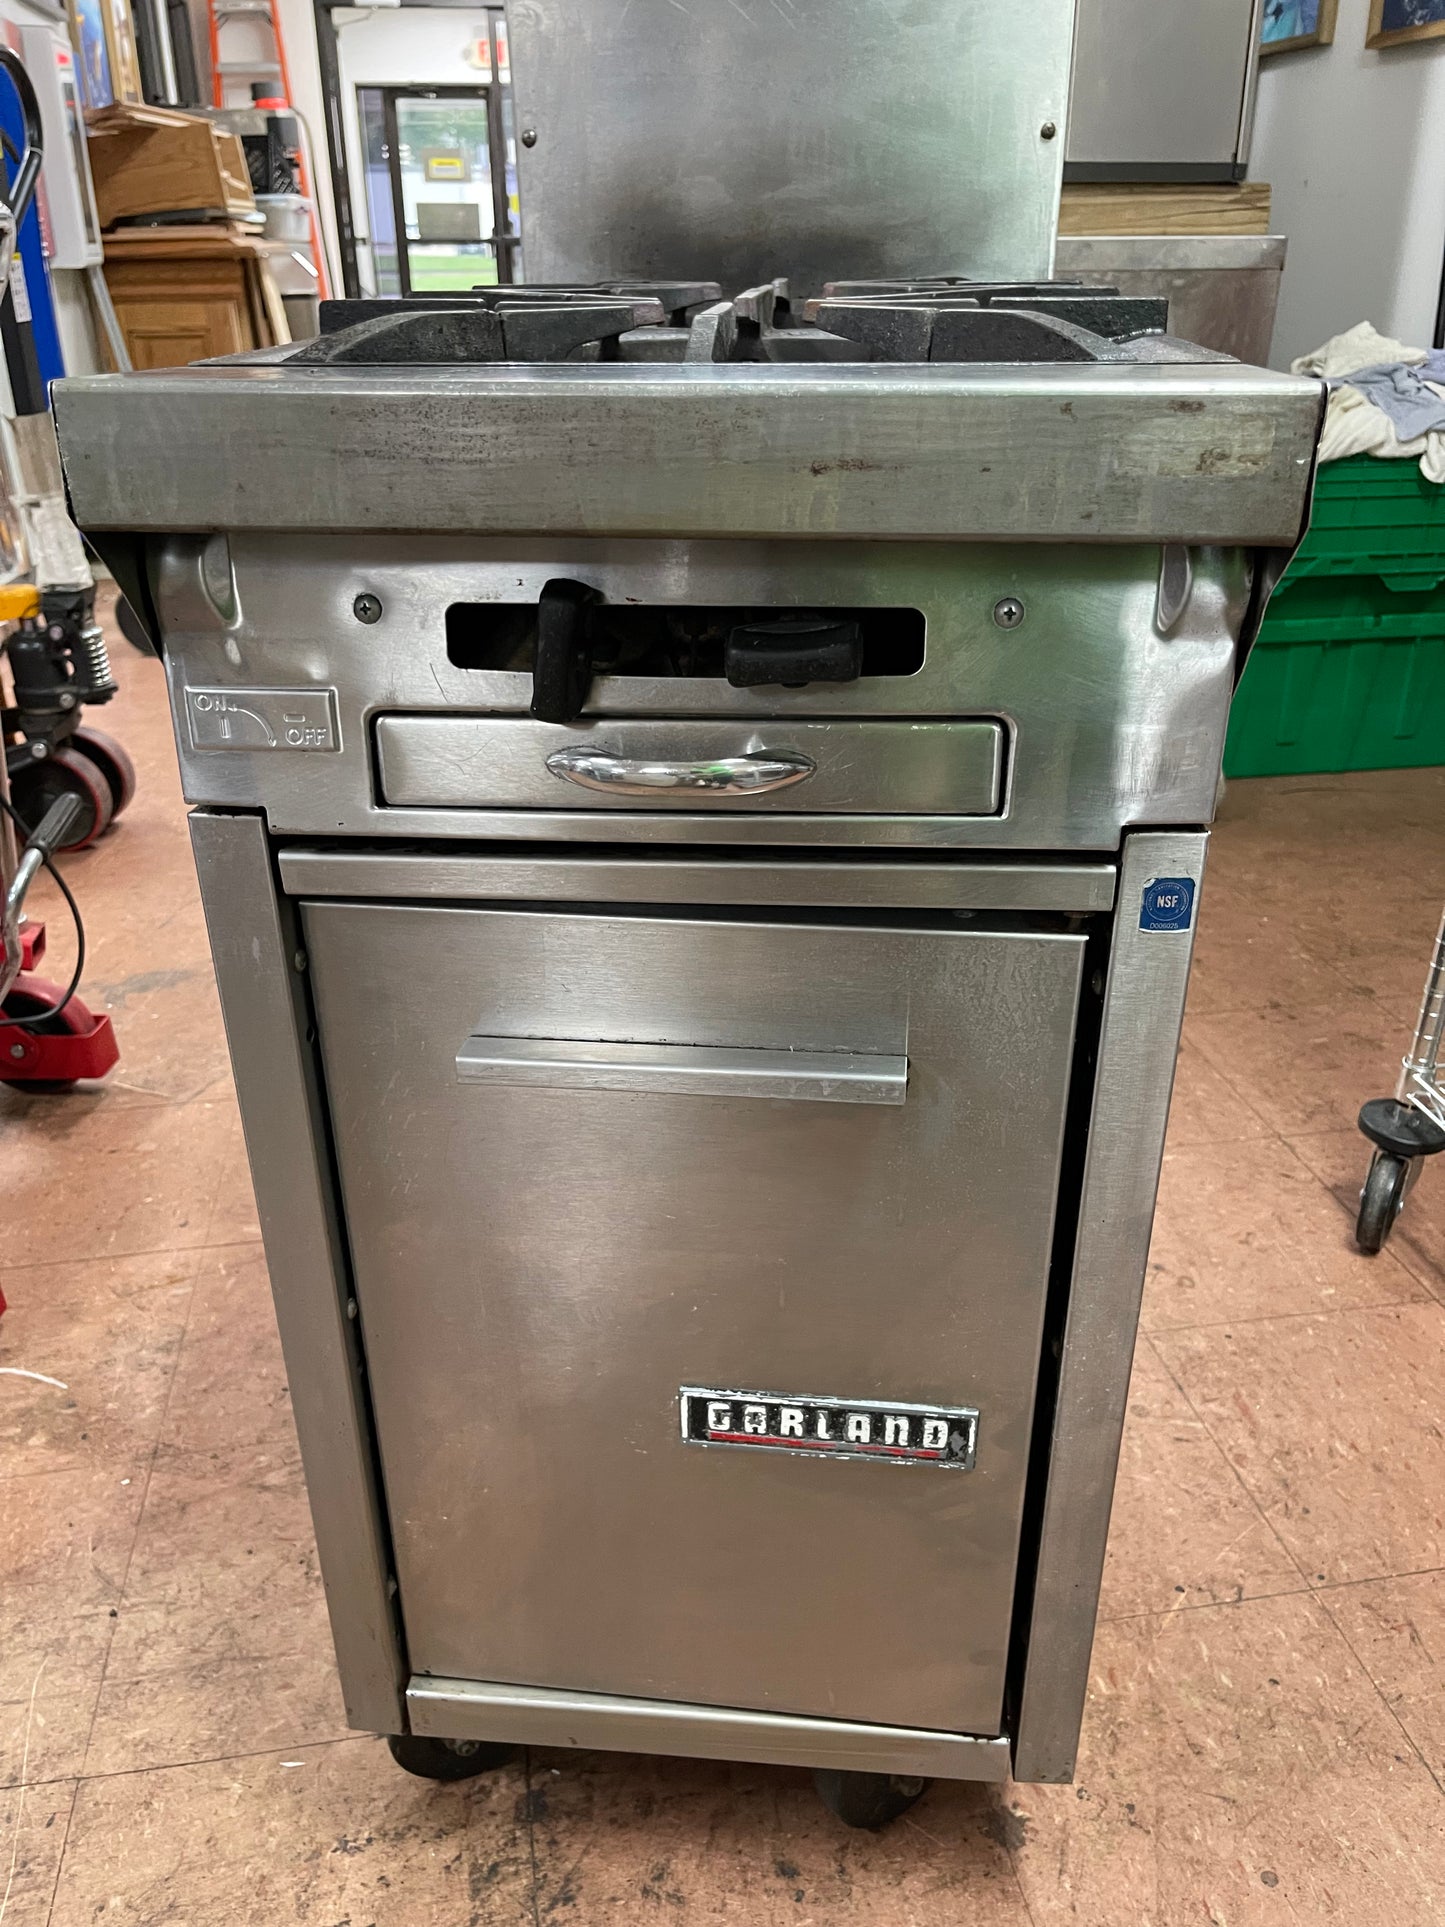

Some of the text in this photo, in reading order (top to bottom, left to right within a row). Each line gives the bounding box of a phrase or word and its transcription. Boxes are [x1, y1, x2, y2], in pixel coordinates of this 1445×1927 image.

[194, 695, 227, 711] ON
[285, 726, 327, 746] OFF
[1156, 895, 1179, 908] NSF
[706, 1400, 949, 1449] GARLAND
